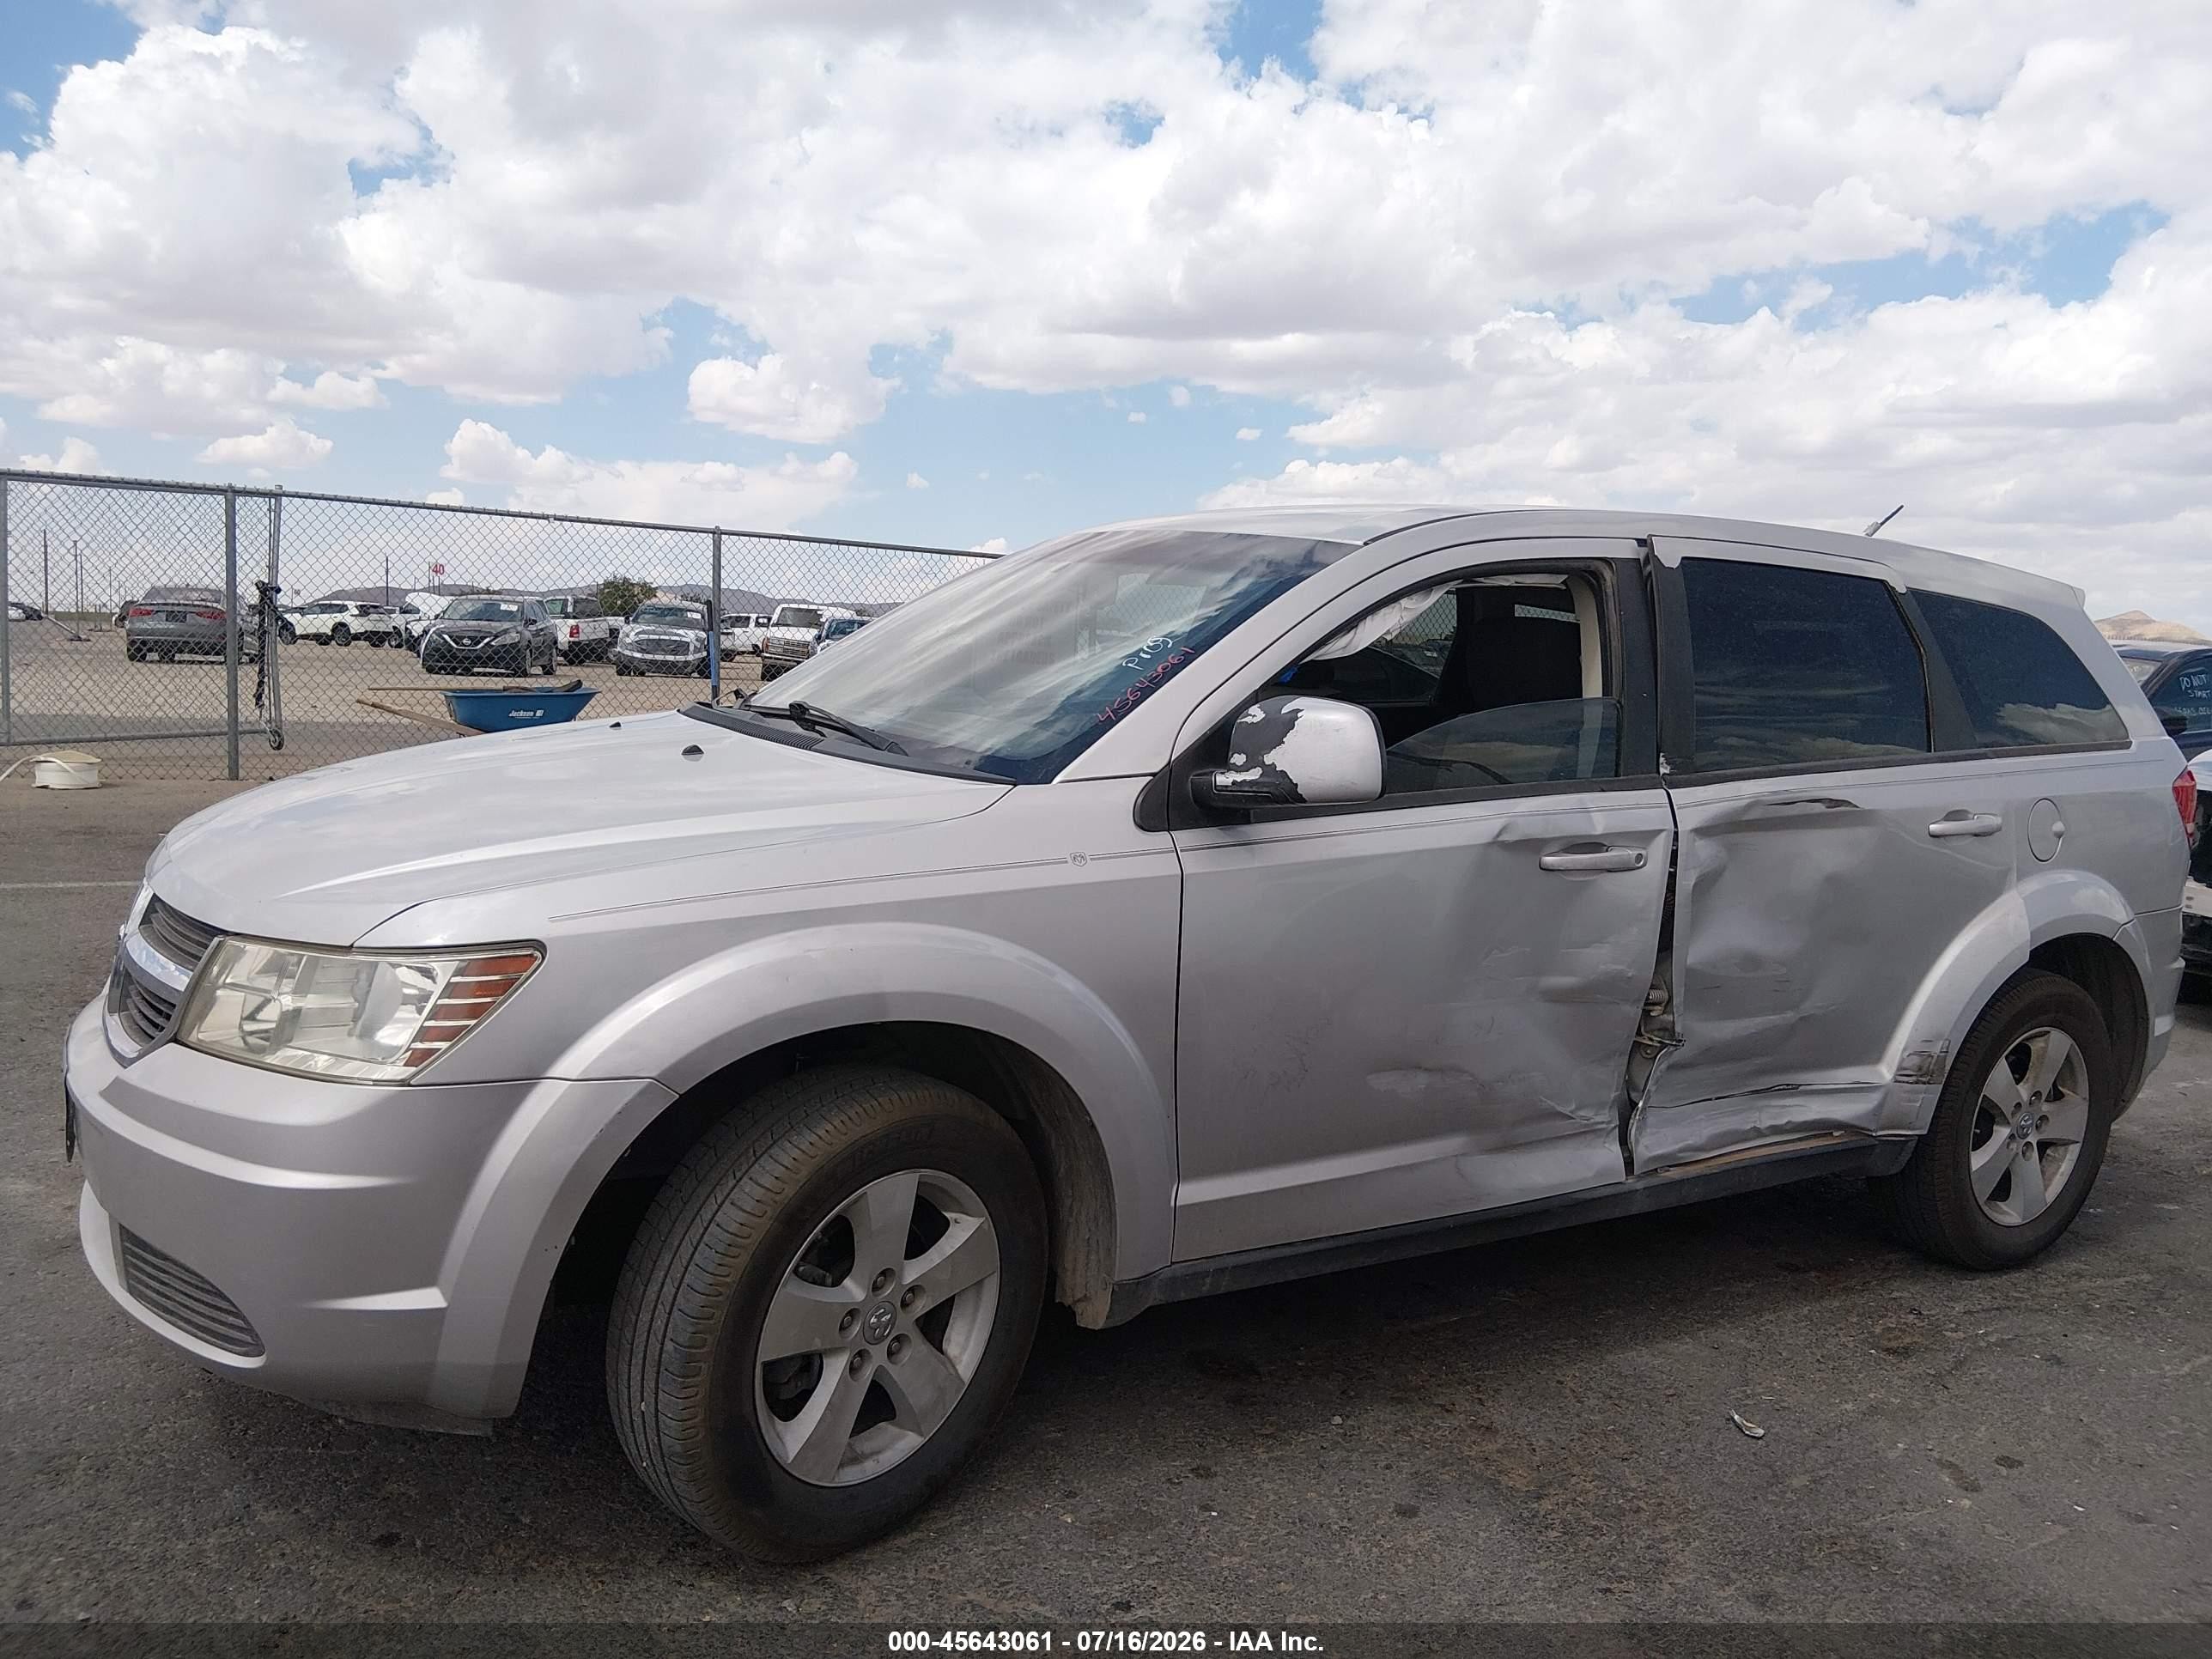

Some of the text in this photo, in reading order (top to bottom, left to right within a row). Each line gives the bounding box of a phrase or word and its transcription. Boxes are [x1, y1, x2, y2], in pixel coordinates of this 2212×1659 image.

[431, 563, 445, 575] 40
[1097, 646, 1196, 721] 45643061
[2179, 674, 2207, 691] DO NOT
